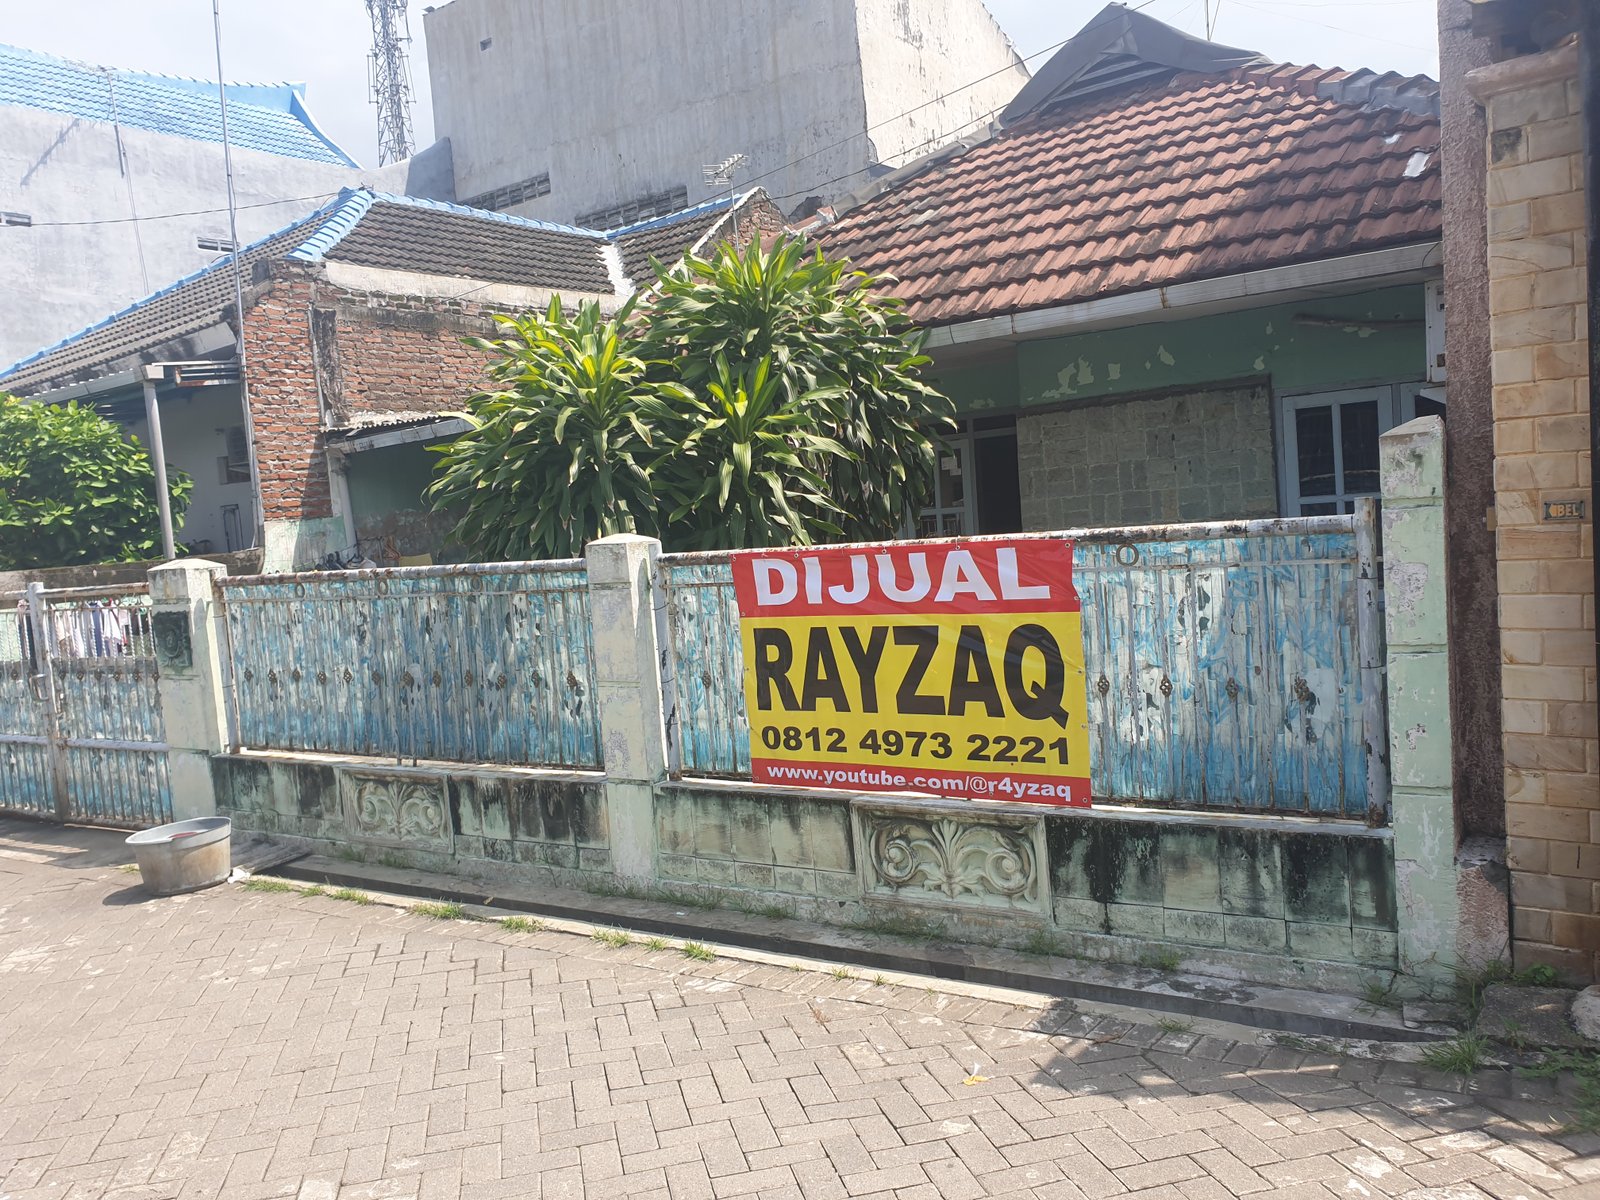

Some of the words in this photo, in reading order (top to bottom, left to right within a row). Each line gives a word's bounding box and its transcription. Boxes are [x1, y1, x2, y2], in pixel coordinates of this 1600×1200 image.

[1557, 503, 1579, 516] BEL
[752, 547, 1051, 606] DIJUAL
[752, 623, 1069, 729] RAYZAQ
[761, 725, 847, 753] 0812
[859, 729, 953, 759] 4973
[966, 734, 1069, 765] 2221
[767, 765, 1072, 801] www.youtube.com/@r4yzaq
